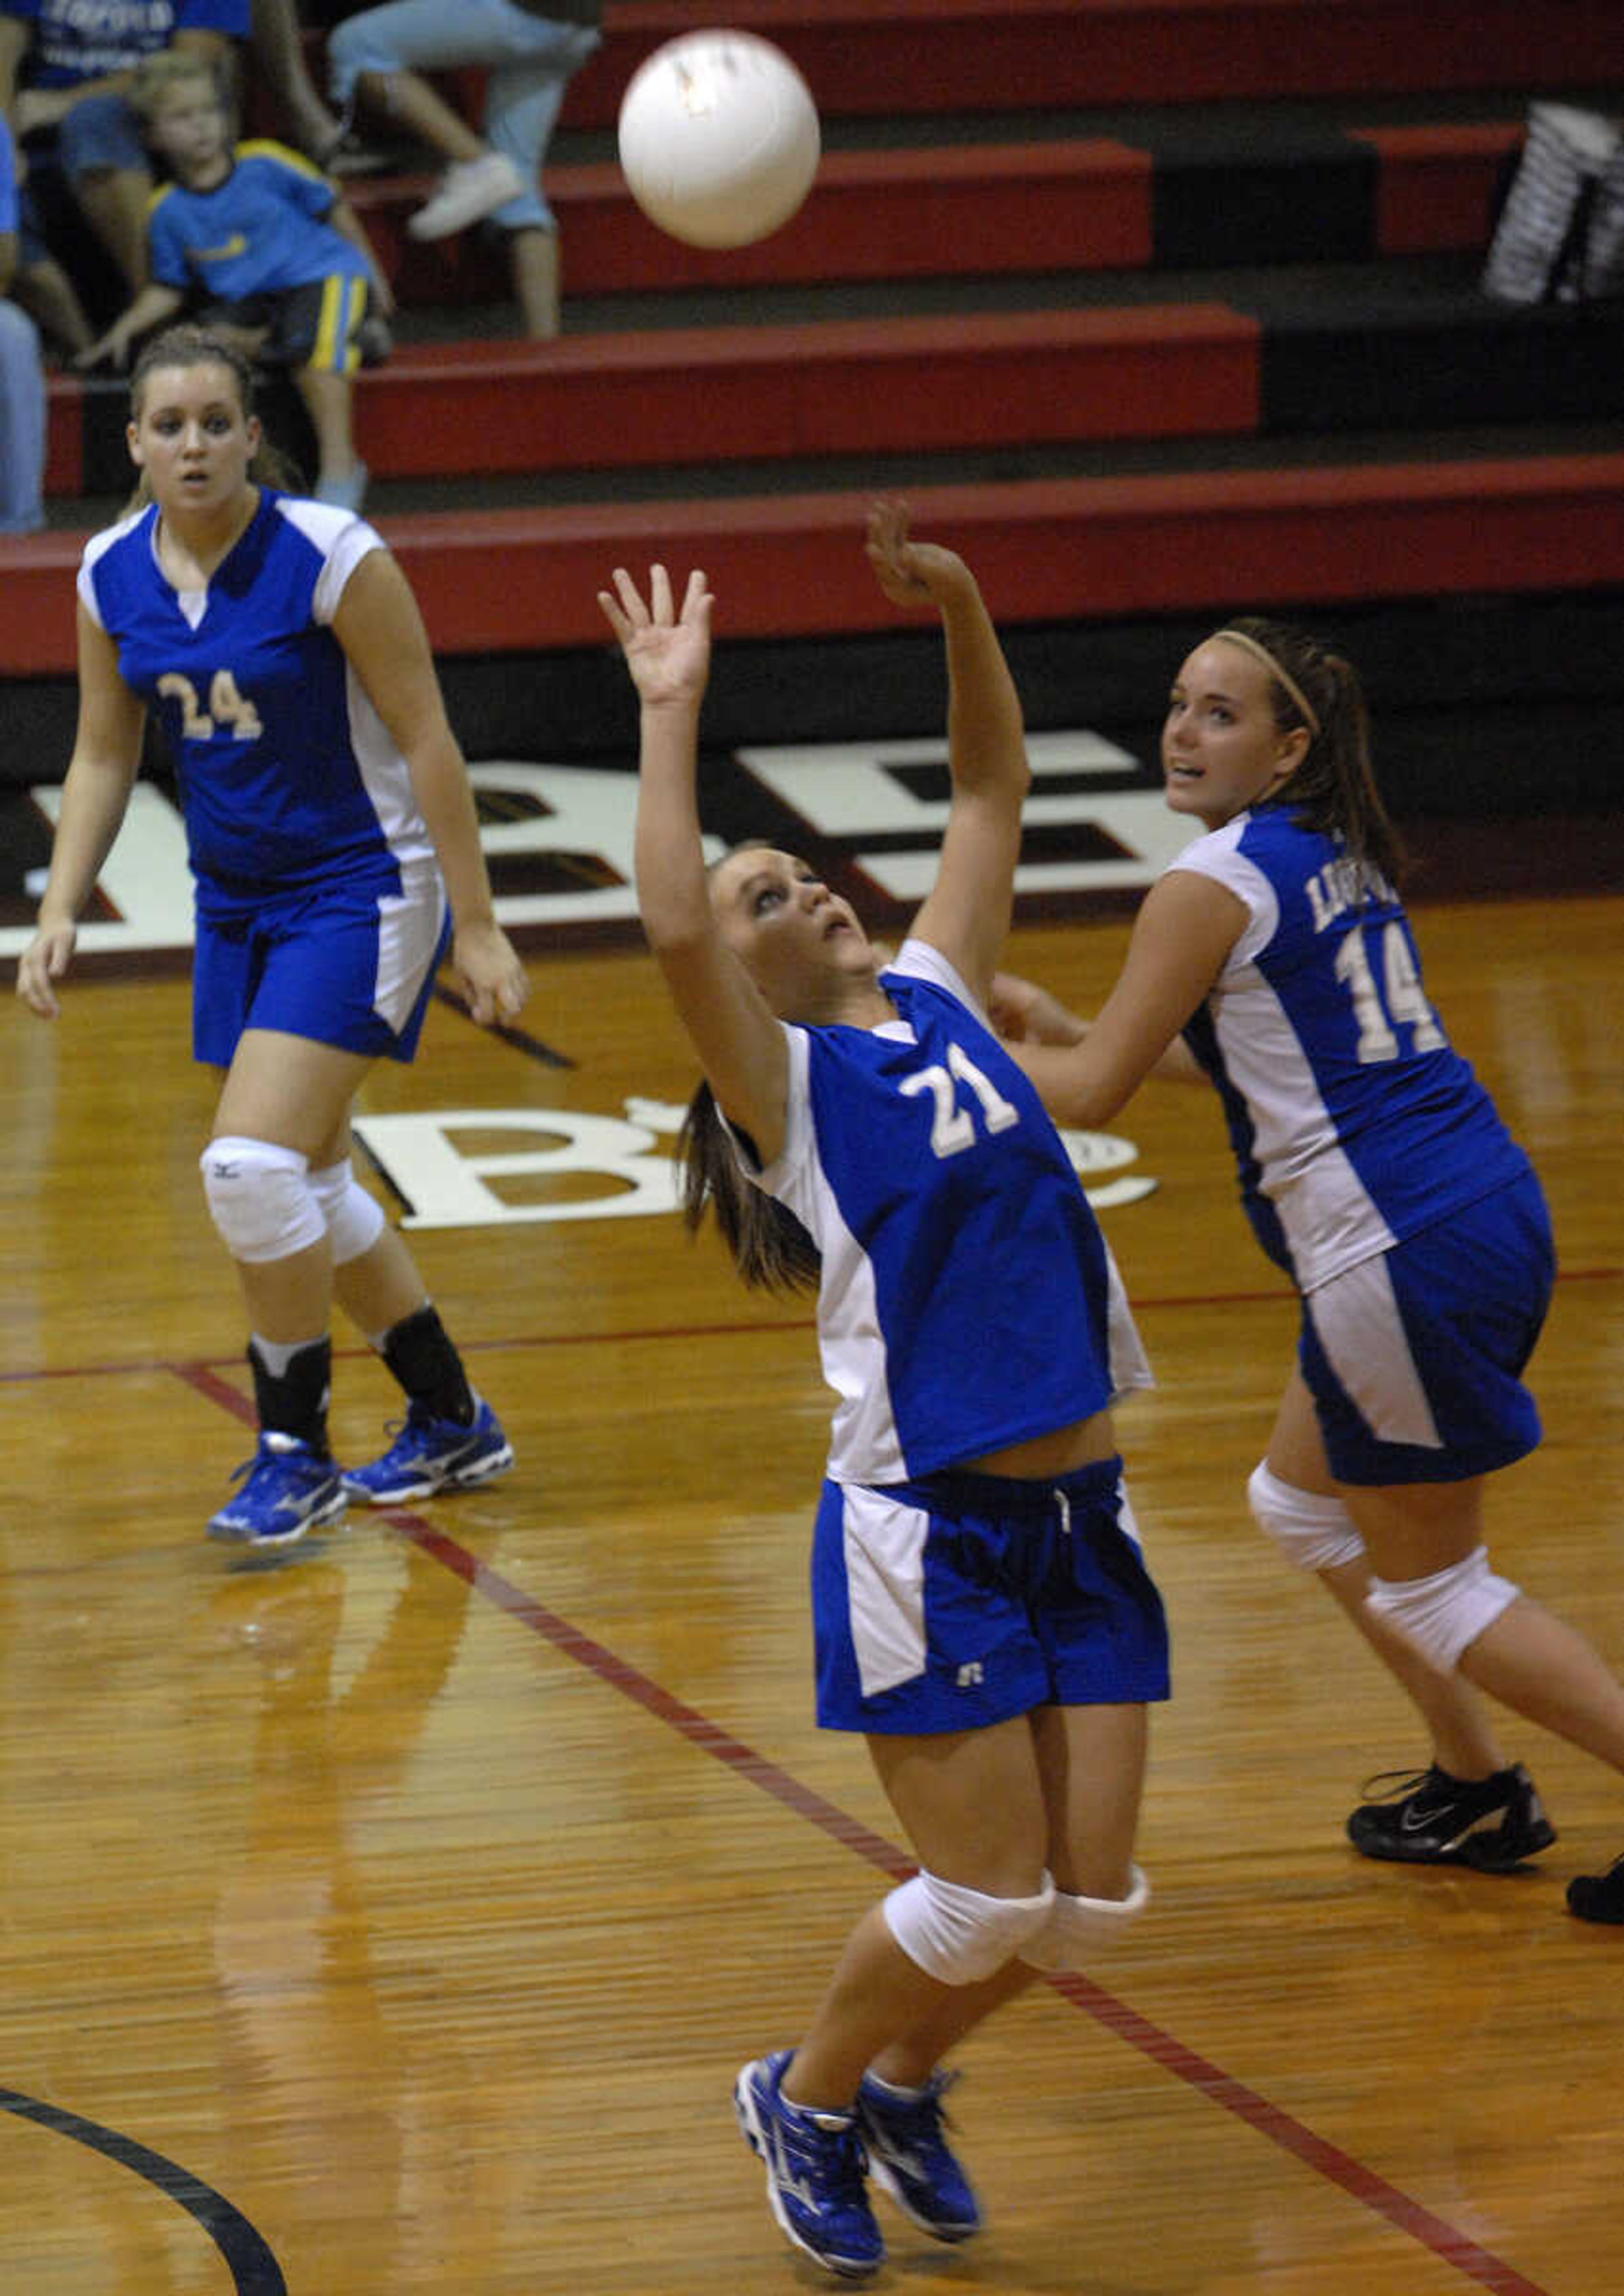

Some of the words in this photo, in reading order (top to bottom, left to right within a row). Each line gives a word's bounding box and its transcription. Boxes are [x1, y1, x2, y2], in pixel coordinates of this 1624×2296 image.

[156, 669, 263, 739] 24
[1334, 921, 1448, 1065] 14
[897, 1041, 1020, 1159] 21
